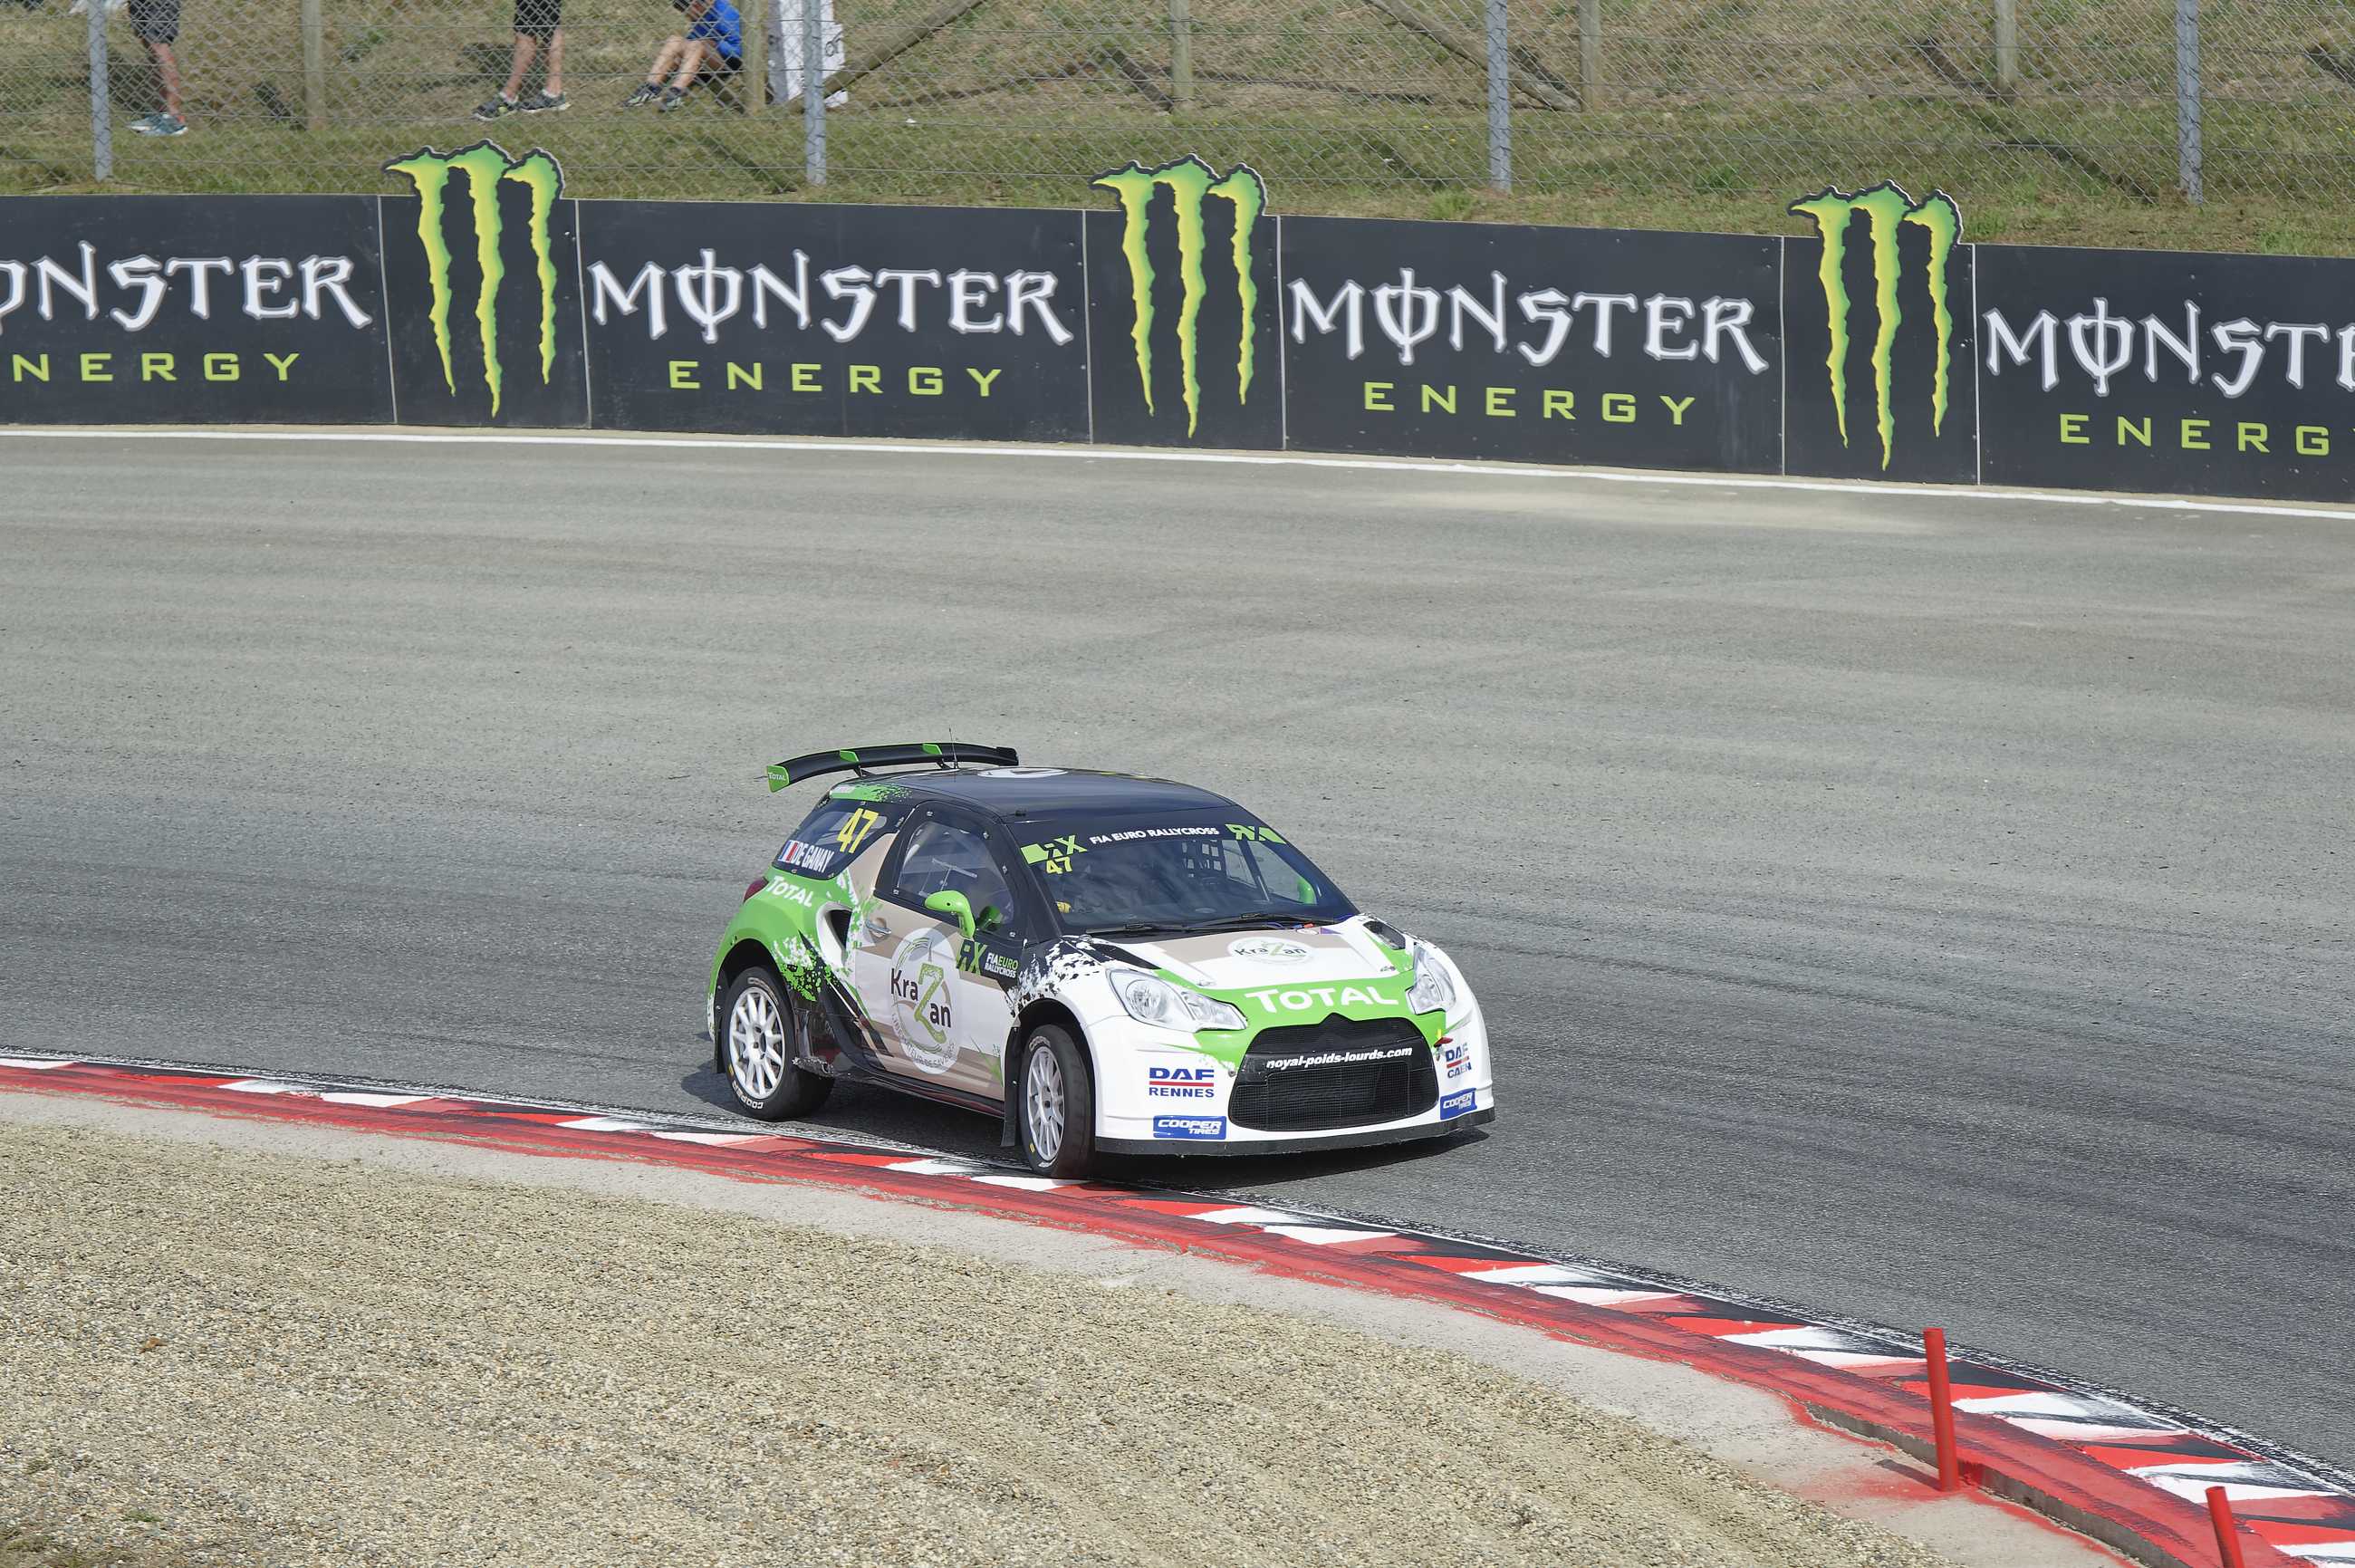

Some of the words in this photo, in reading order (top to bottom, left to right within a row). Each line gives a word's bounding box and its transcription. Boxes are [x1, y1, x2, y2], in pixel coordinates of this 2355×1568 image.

[590, 247, 1075, 347] MONSTER
[1289, 267, 1769, 372] MONSTER
[668, 360, 1003, 398] ENERGY
[1362, 381, 1696, 426] ENERGY
[2059, 413, 2355, 457] ENERG
[837, 807, 879, 853] 47
[1089, 834, 1113, 845] FIA
[1112, 829, 1147, 842] EURO
[1148, 827, 1220, 838] RALLYCROSS
[791, 841, 809, 868] DE
[1045, 856, 1072, 875] 47
[766, 875, 814, 908] TOTAL
[984, 962, 1016, 978] RALLYCROSS
[1245, 986, 1399, 1015] TOTAL
[1445, 1043, 1469, 1062] DAF
[1149, 1067, 1215, 1081] DAF
[1149, 1086, 1215, 1098] RENNES
[1442, 1092, 1473, 1109] COOPER
[1158, 1119, 1223, 1130] COOPER
[1188, 1127, 1220, 1135] TIRES
